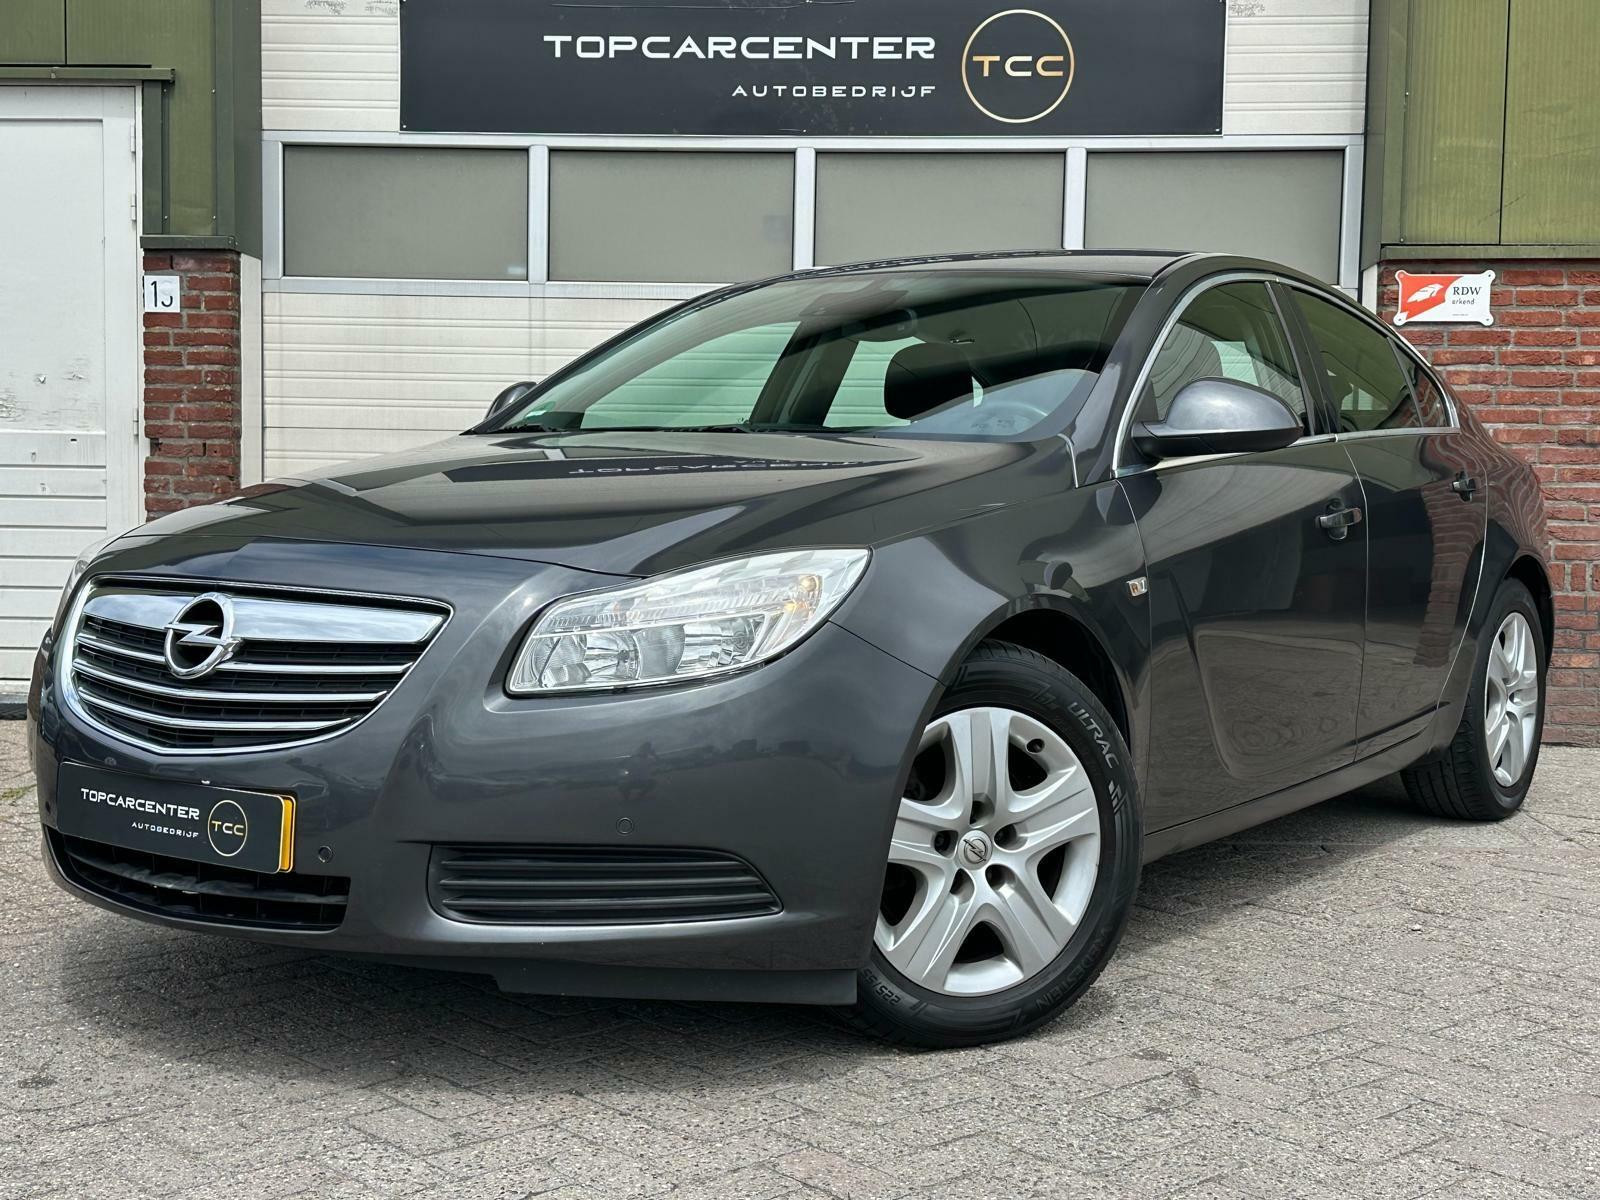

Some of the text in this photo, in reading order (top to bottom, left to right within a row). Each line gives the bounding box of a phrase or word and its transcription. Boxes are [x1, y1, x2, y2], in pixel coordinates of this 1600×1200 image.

[543, 35, 936, 60] TOPCARCENTER
[972, 55, 1064, 77] TCC
[731, 84, 936, 98] AUTOBEDRIJF
[1452, 286, 1482, 296] RDW
[1067, 702, 1119, 768] ULTRAC
[80, 787, 200, 820] TOPCARCENTER
[131, 821, 199, 838] AUTOBEDRIJF
[211, 820, 244, 836] TCC
